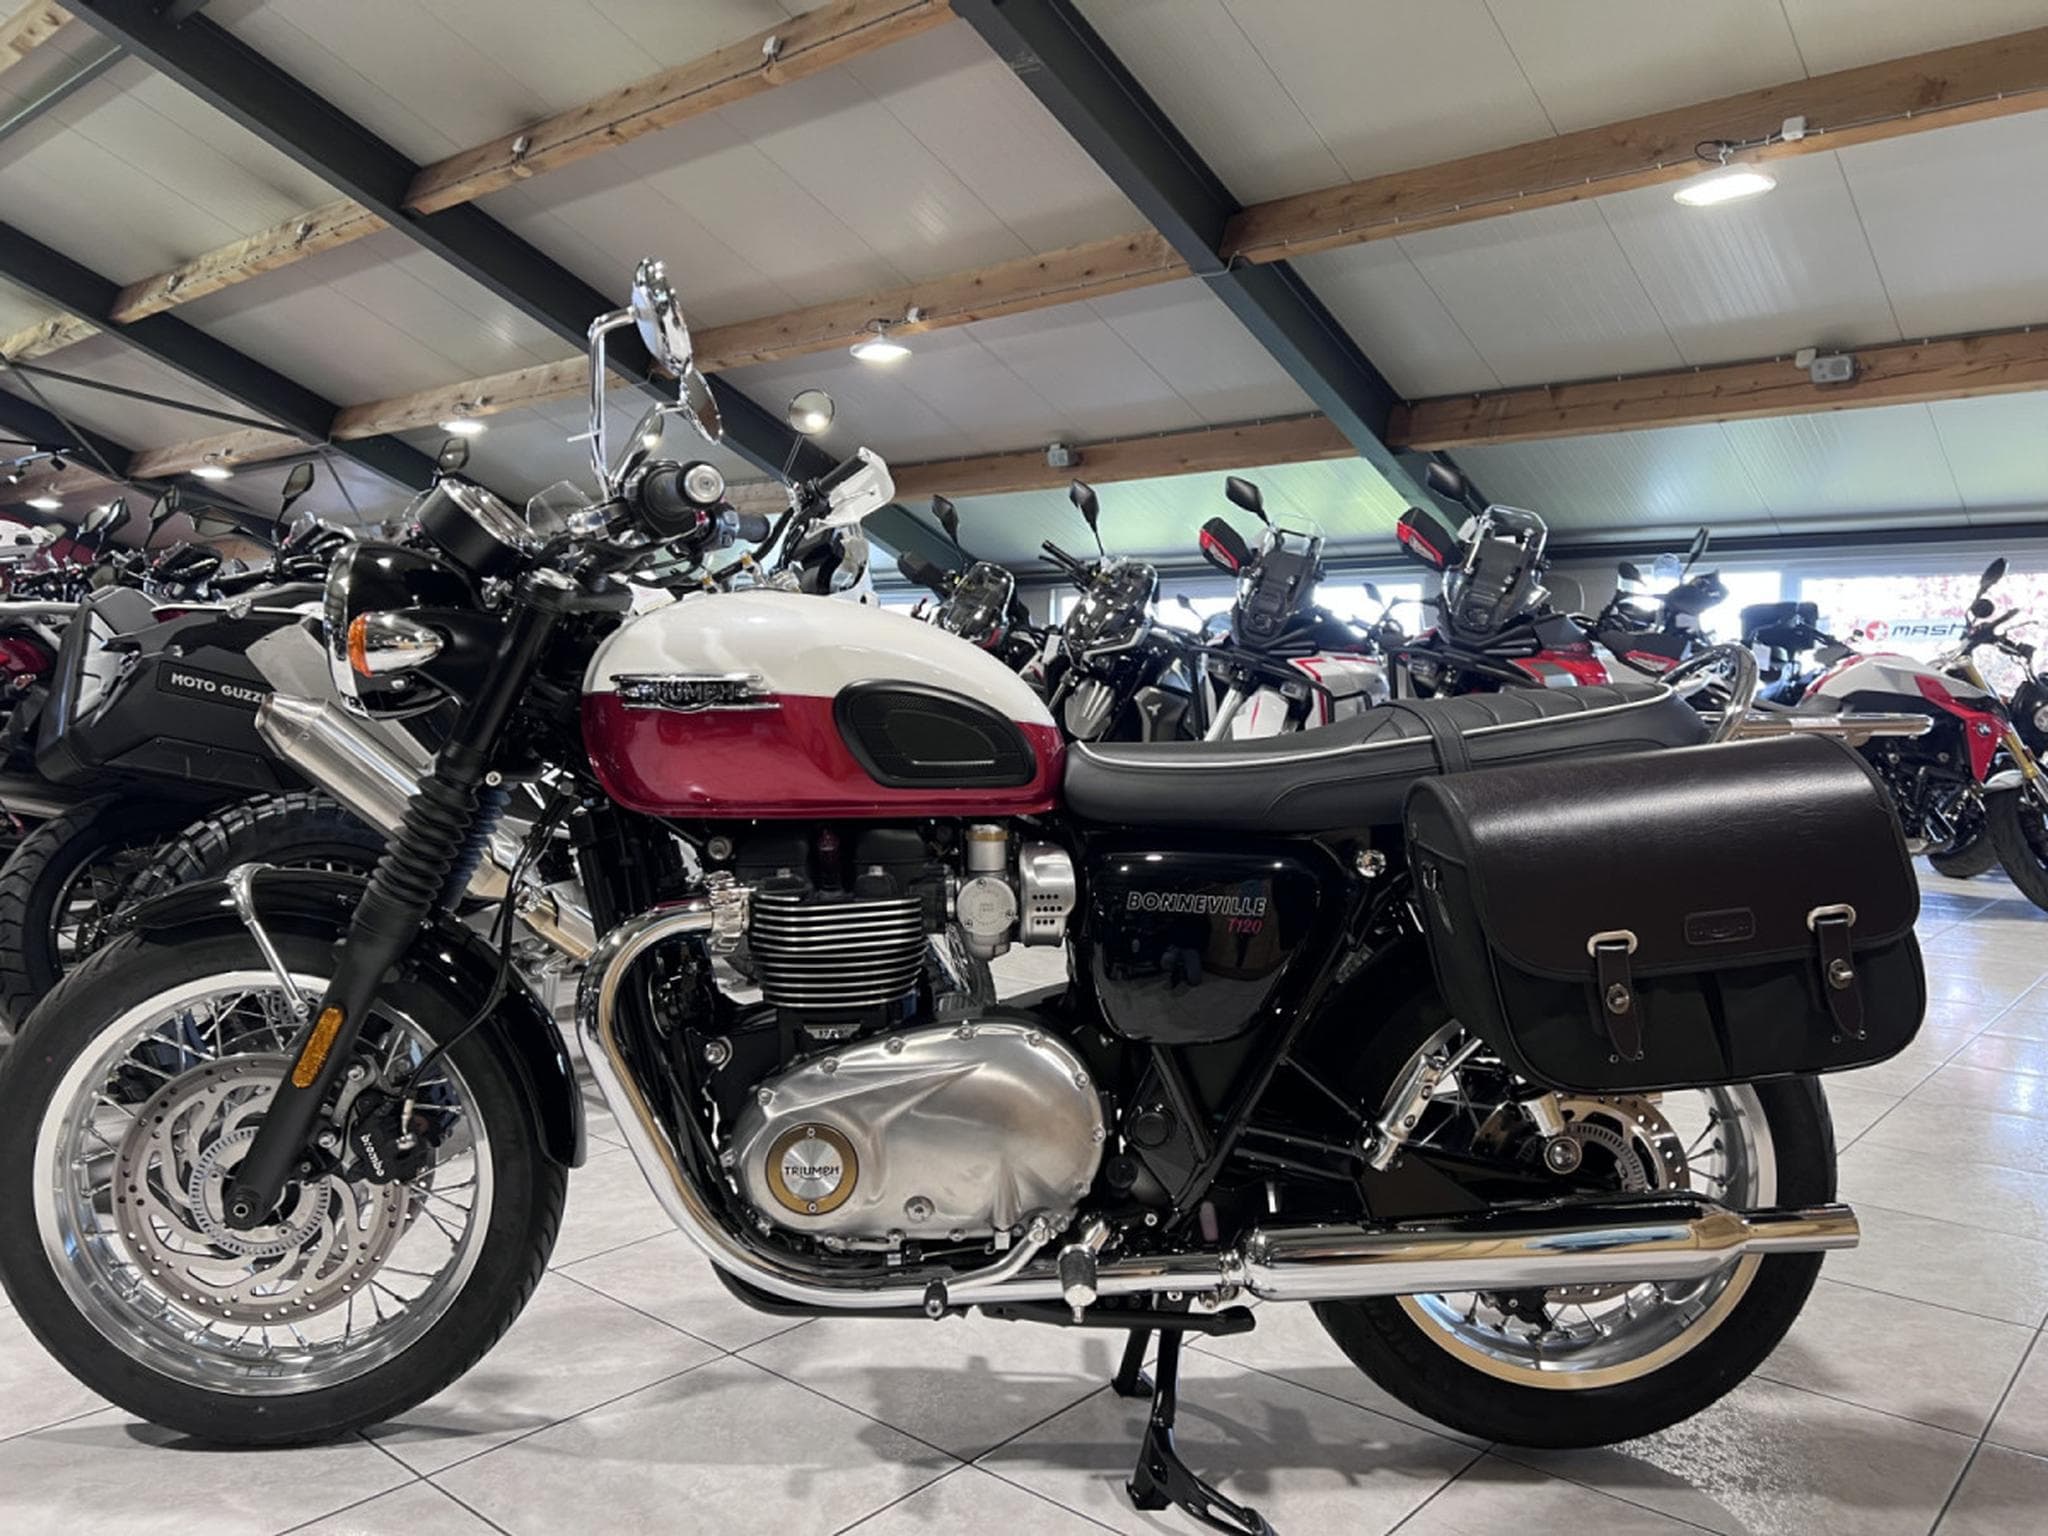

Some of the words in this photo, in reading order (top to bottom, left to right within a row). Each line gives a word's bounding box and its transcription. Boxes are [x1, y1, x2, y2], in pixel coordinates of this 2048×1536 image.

[171, 672, 217, 693] MOTO
[1126, 891, 1267, 917] BONNEVILLE
[360, 1132, 385, 1177] brembo
[784, 1165, 840, 1177] TRIUMPH
